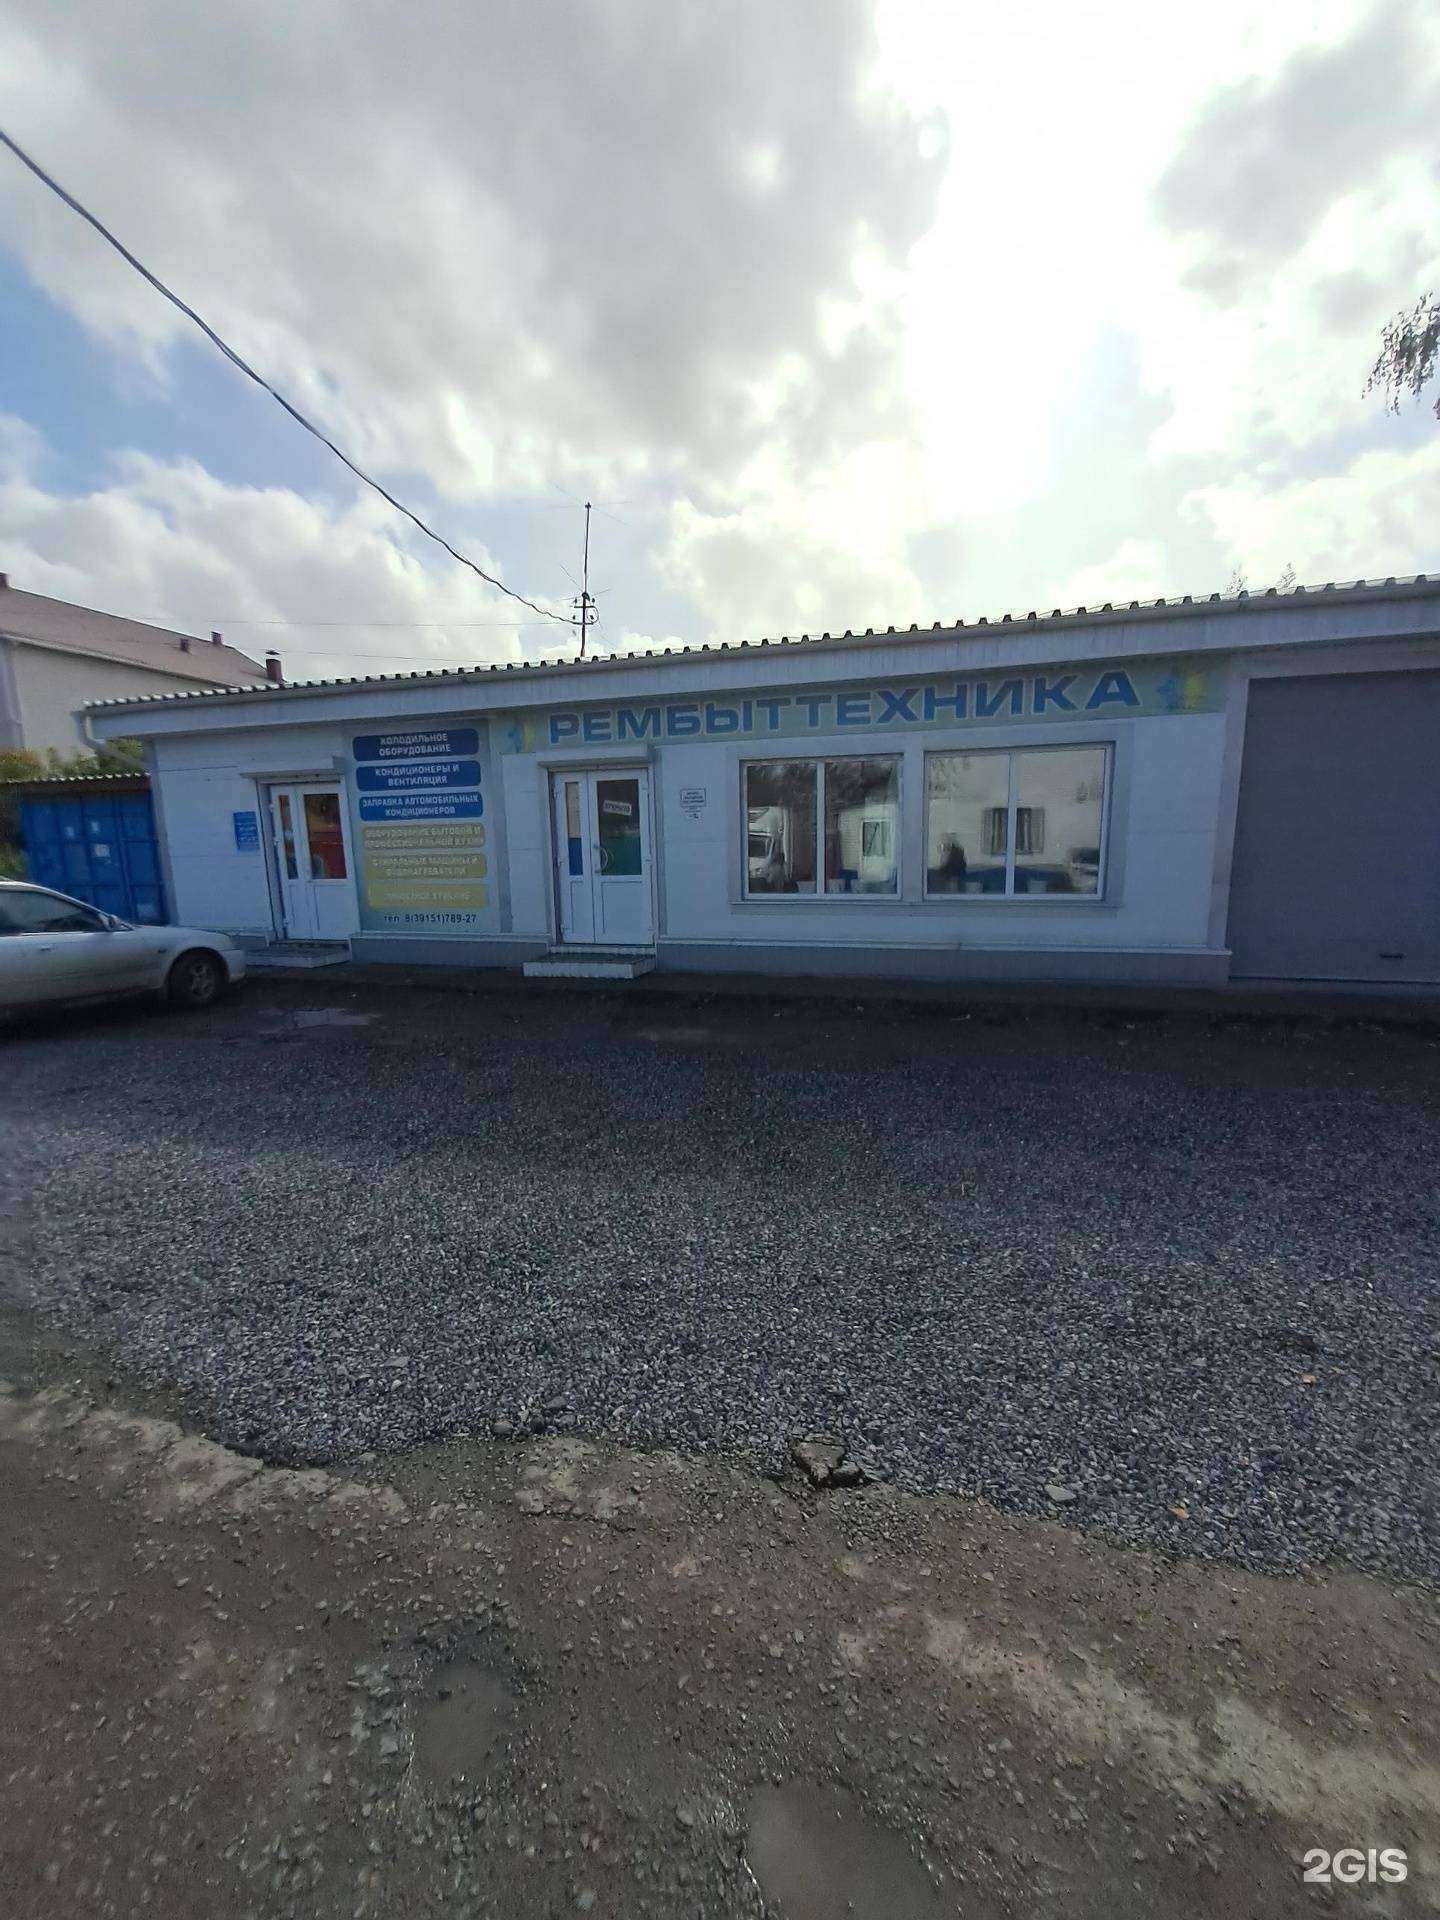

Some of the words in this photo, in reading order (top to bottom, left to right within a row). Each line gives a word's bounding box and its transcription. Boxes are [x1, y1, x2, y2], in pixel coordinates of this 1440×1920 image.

[549, 670, 1142, 745] РЕМБЫТТЕХНИКА
[379, 733, 448, 746] ХОЛОДИЛЬНОЕ
[378, 744, 451, 756] ОБОРУДОВАНИЕ
[375, 765, 450, 777] КОНДИЦИОНЕРЫ
[451, 764, 460, 773] И
[388, 776, 448, 787] ВЕНТИЛЯЦИЯ
[362, 797, 403, 807] ЗАПРАВКА
[404, 794, 480, 805] АВТОМОБИЛЬНЫХ
[385, 806, 456, 817] КОНДИЦИОНЕРОВ
